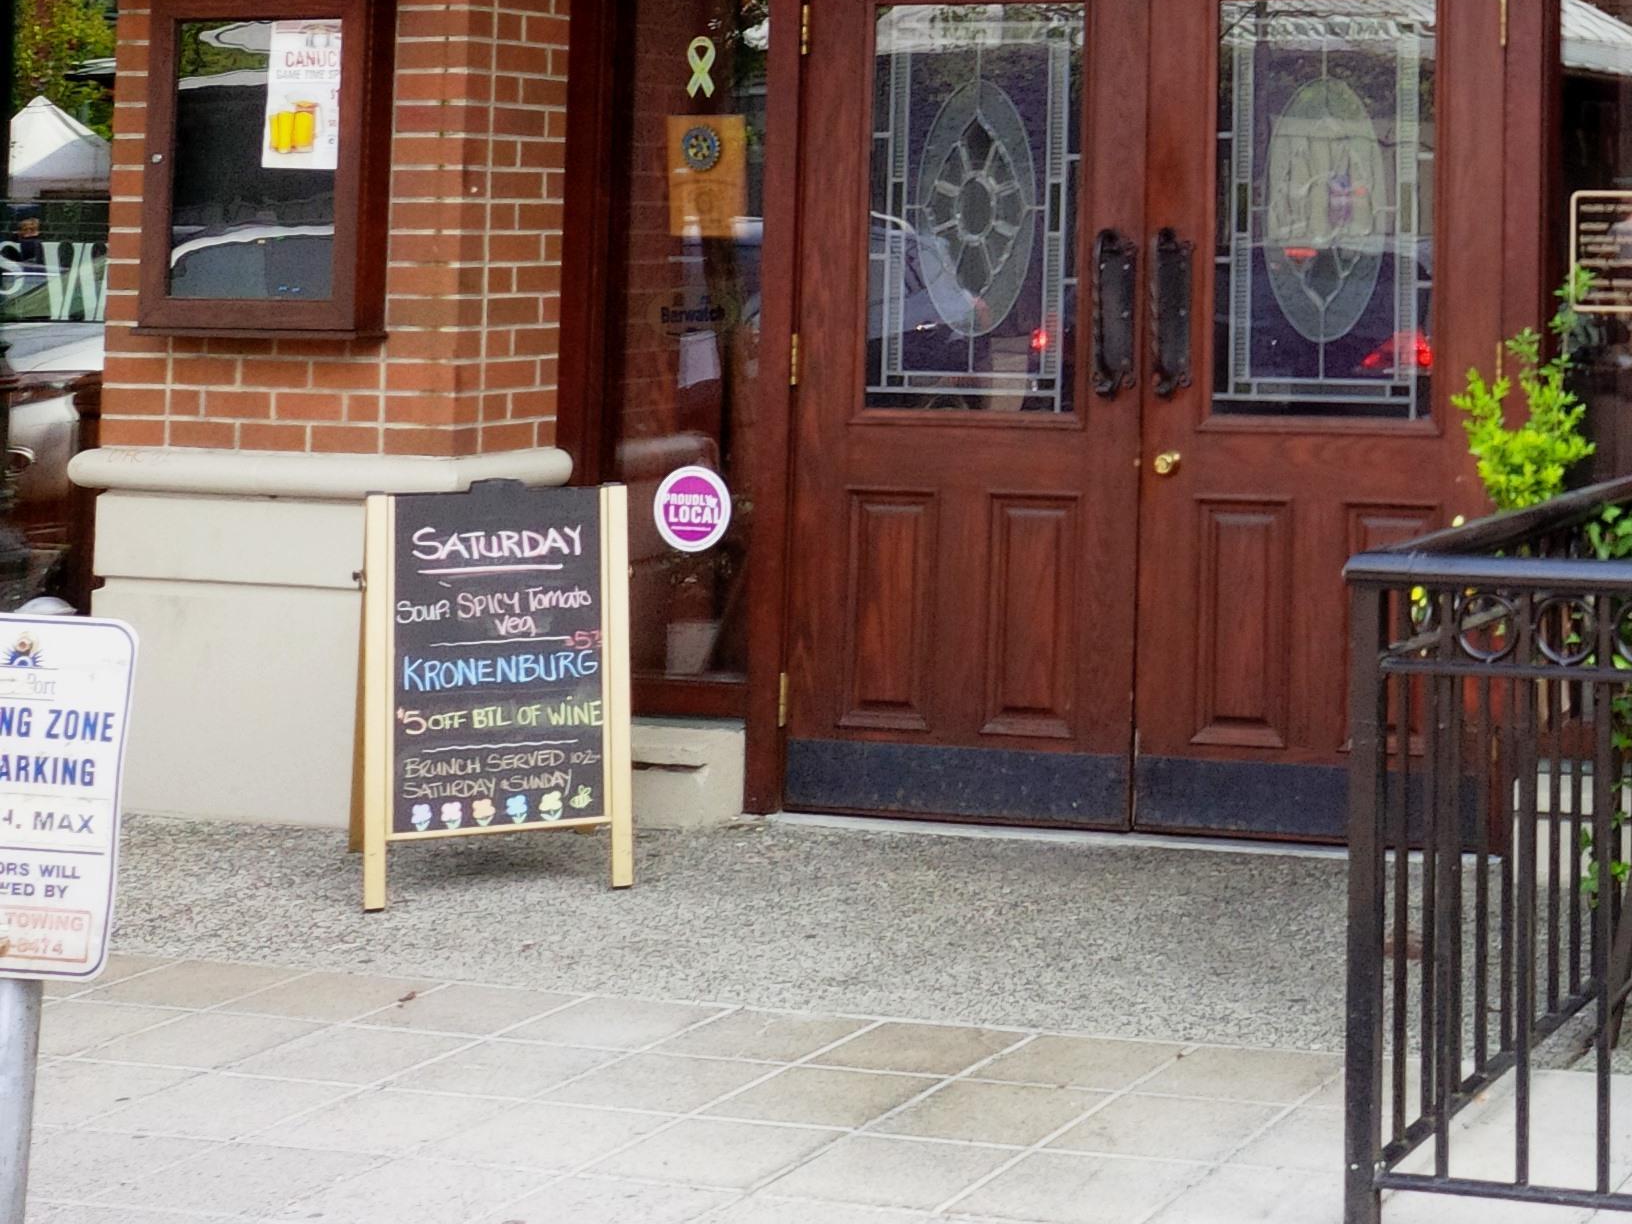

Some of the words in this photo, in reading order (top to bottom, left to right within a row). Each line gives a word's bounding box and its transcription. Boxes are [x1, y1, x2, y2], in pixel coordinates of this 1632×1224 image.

[668, 505, 720, 524] LOCAL
[412, 525, 582, 560] SATURDAY
[456, 591, 520, 619] SPICY
[403, 650, 598, 692] KRONENBURG
[45, 709, 115, 742] ZONE
[472, 705, 512, 729] BTL
[517, 704, 541, 726] OF
[0, 754, 96, 786] ARKING
[404, 756, 480, 778] BRUNCH
[485, 749, 565, 772] SERVED
[402, 778, 496, 800] SATURDAY
[33, 810, 95, 835] MAX
[39, 863, 81, 880] WILL
[44, 884, 68, 899] BY
[5, 911, 85, 932] TOWING
